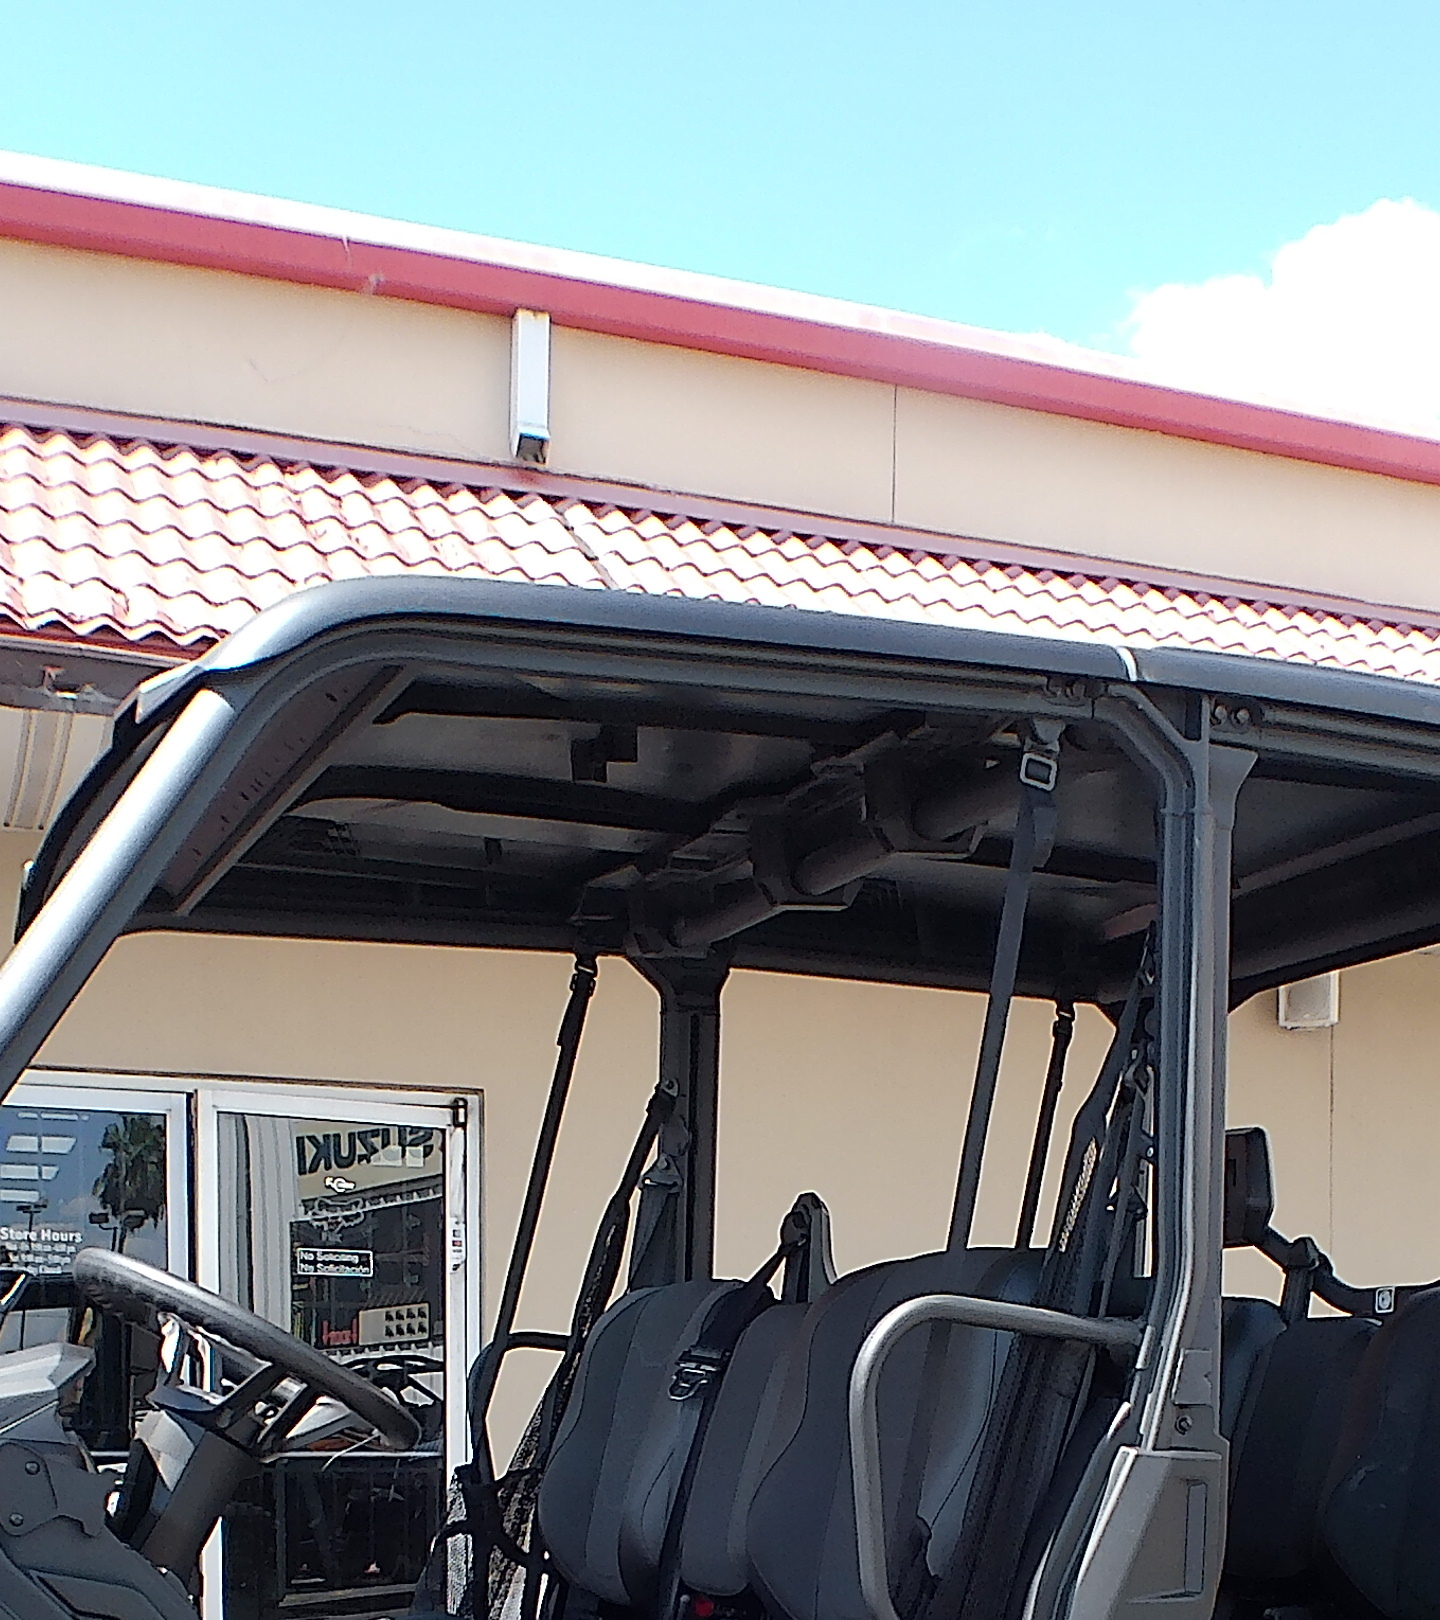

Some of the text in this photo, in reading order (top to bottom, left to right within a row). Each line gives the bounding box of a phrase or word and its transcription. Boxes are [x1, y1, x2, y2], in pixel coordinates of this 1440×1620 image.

[0, 1226, 83, 1244] Store Hours
[300, 1251, 315, 1261] No
